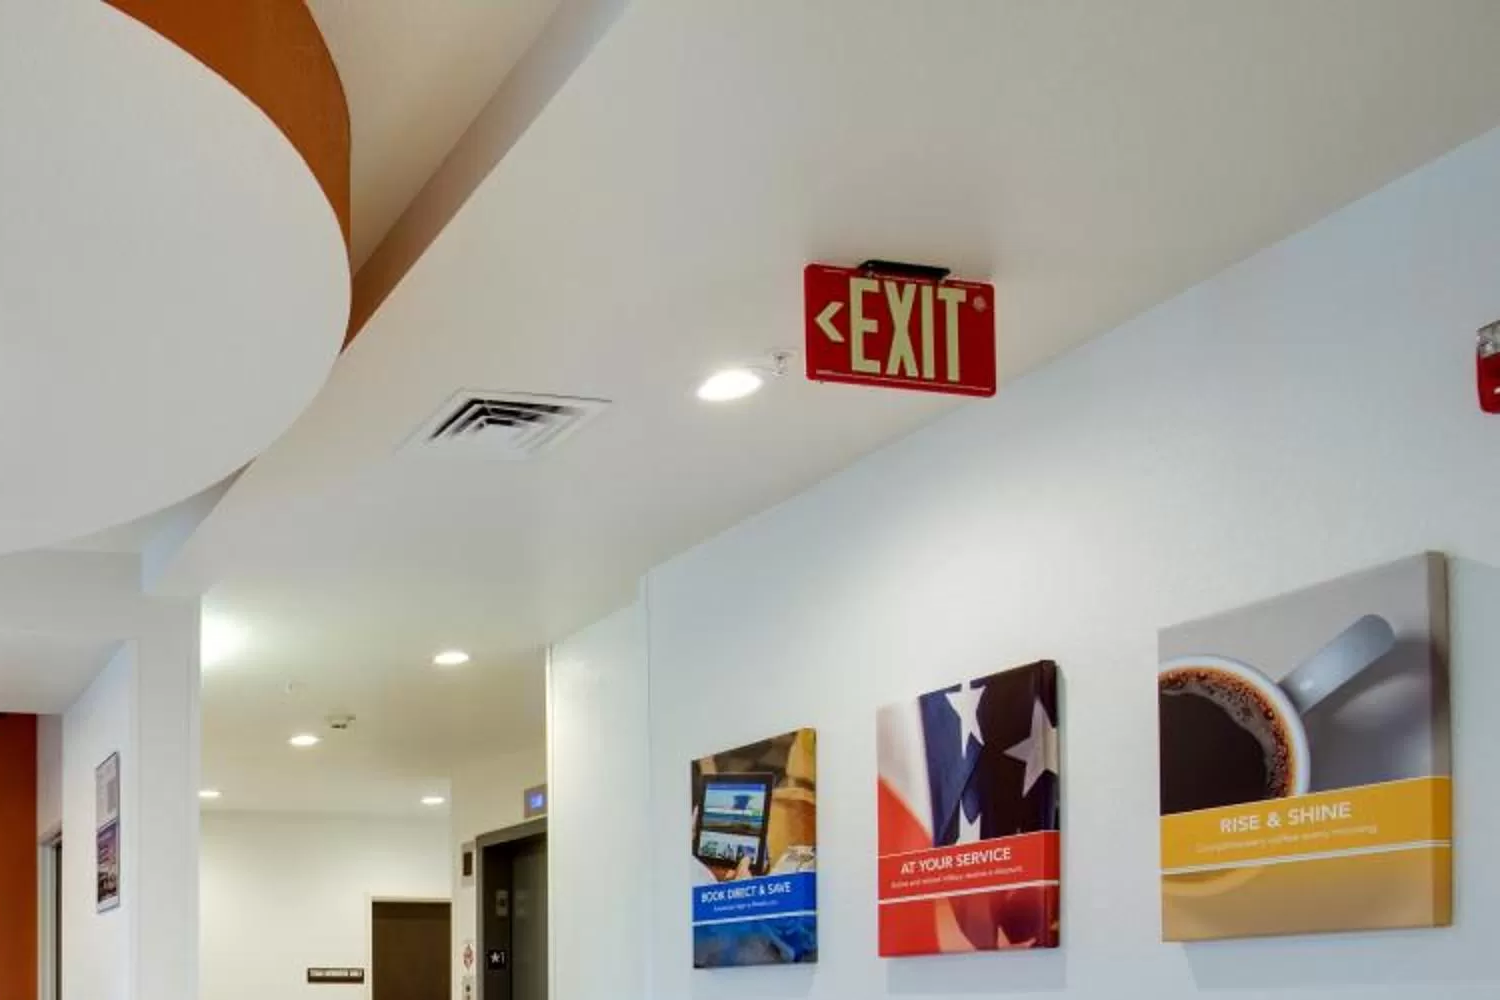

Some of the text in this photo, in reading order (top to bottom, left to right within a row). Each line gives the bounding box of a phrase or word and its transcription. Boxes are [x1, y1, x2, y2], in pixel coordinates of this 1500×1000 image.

[850, 277, 967, 383] EXIT
[1220, 802, 1352, 833] RISE & SHINE
[901, 847, 1011, 875] AT YOUR SERVICE
[701, 891, 725, 903] BOOK
[767, 881, 792, 895] SAVE
